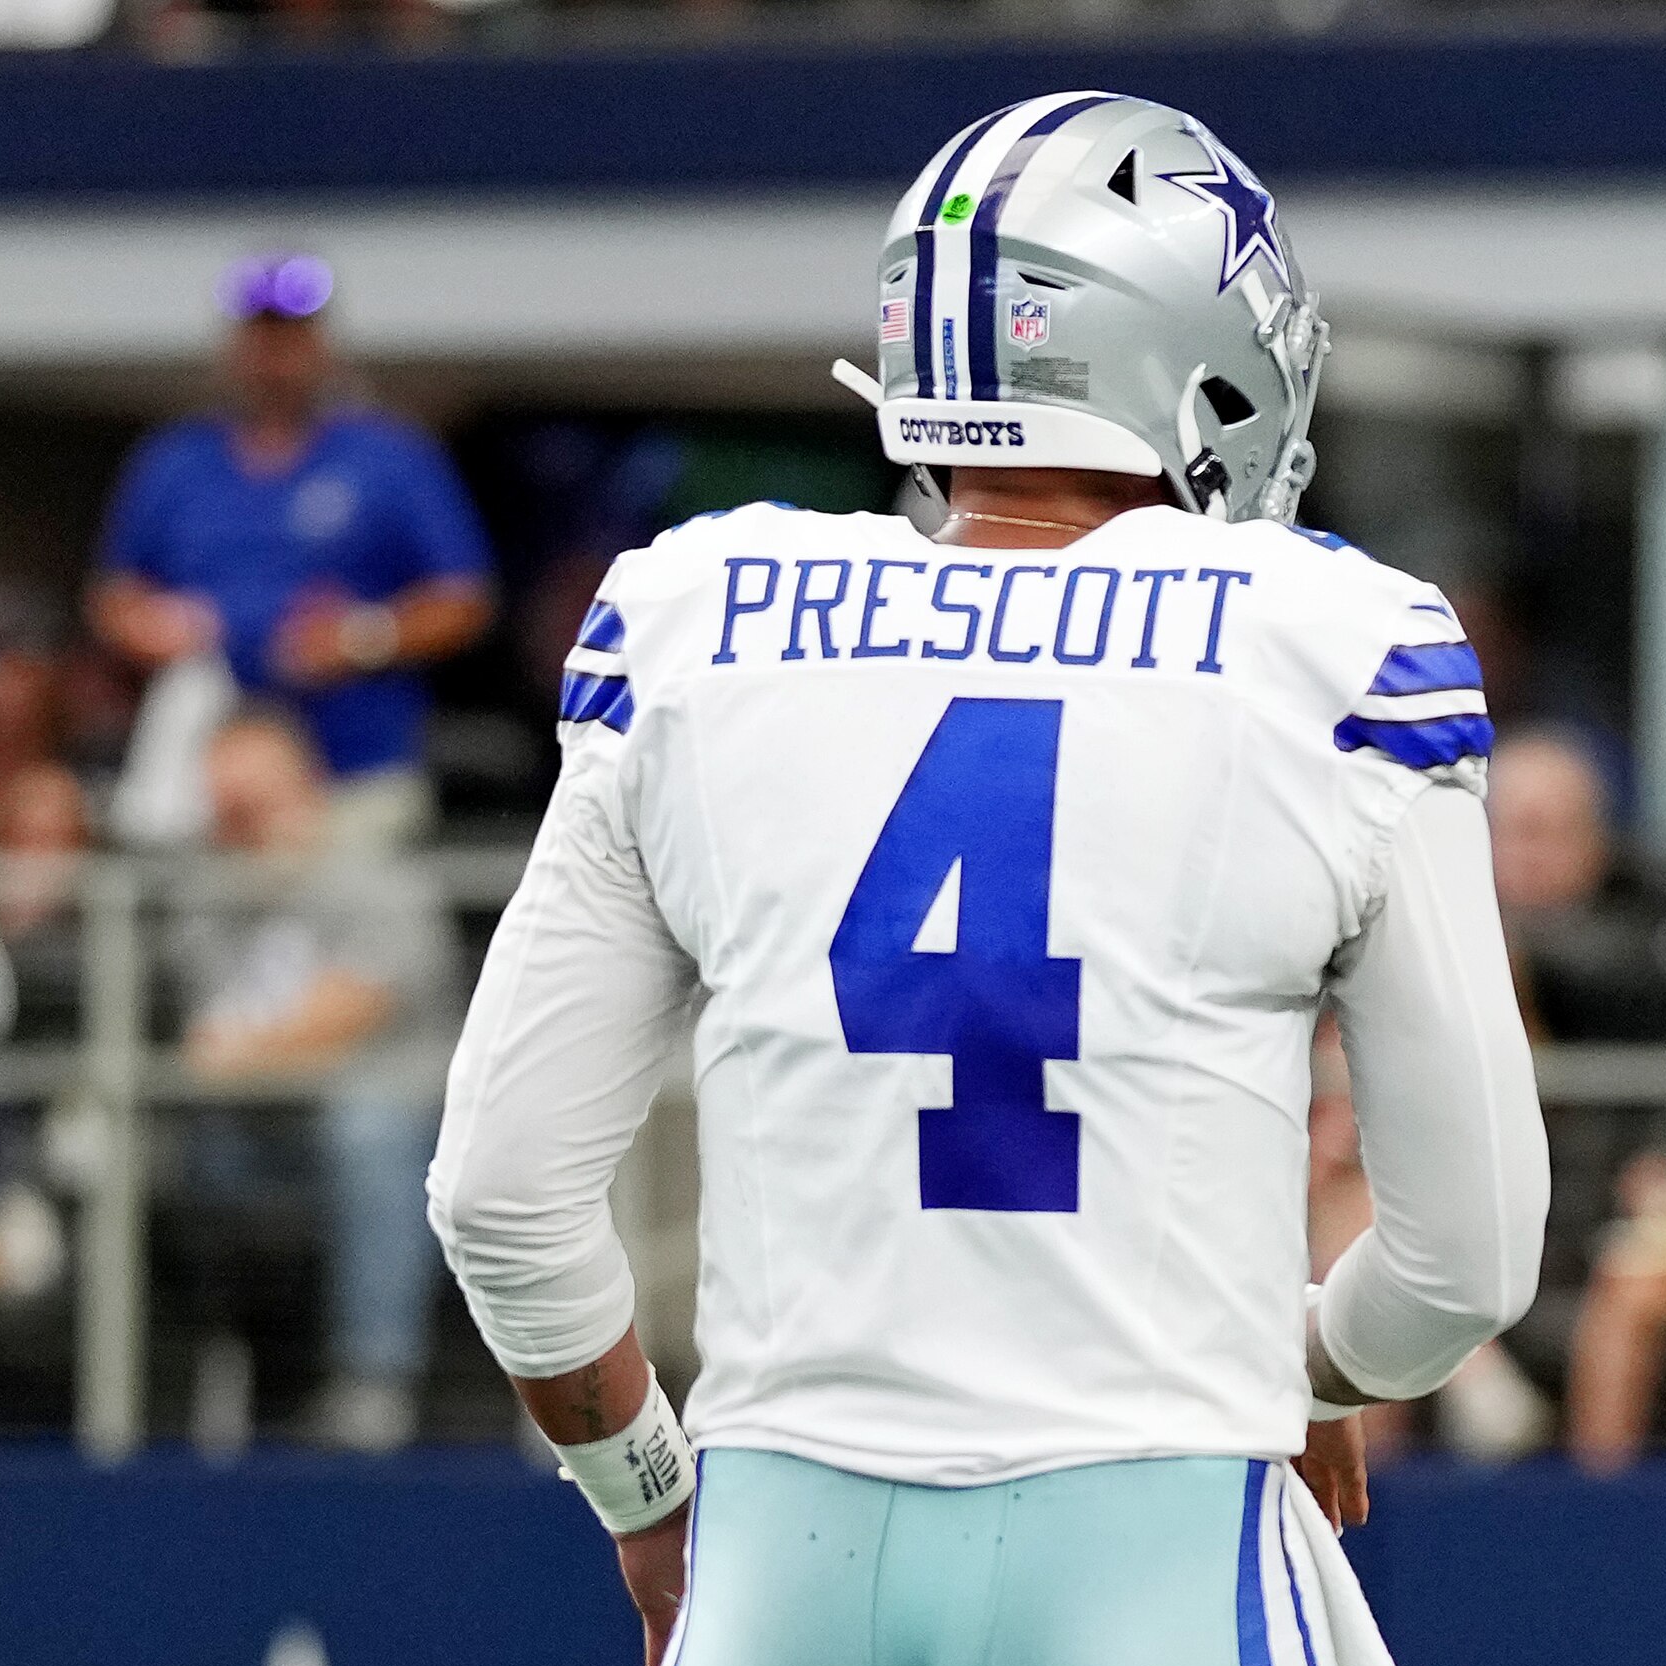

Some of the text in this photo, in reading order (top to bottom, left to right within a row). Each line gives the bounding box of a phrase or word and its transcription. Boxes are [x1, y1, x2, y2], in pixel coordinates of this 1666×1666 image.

[1014, 318, 1044, 340] NFL
[899, 418, 1025, 446] COWBOYS
[711, 557, 1251, 675] PRESCOTT
[829, 697, 1081, 1213] 4
